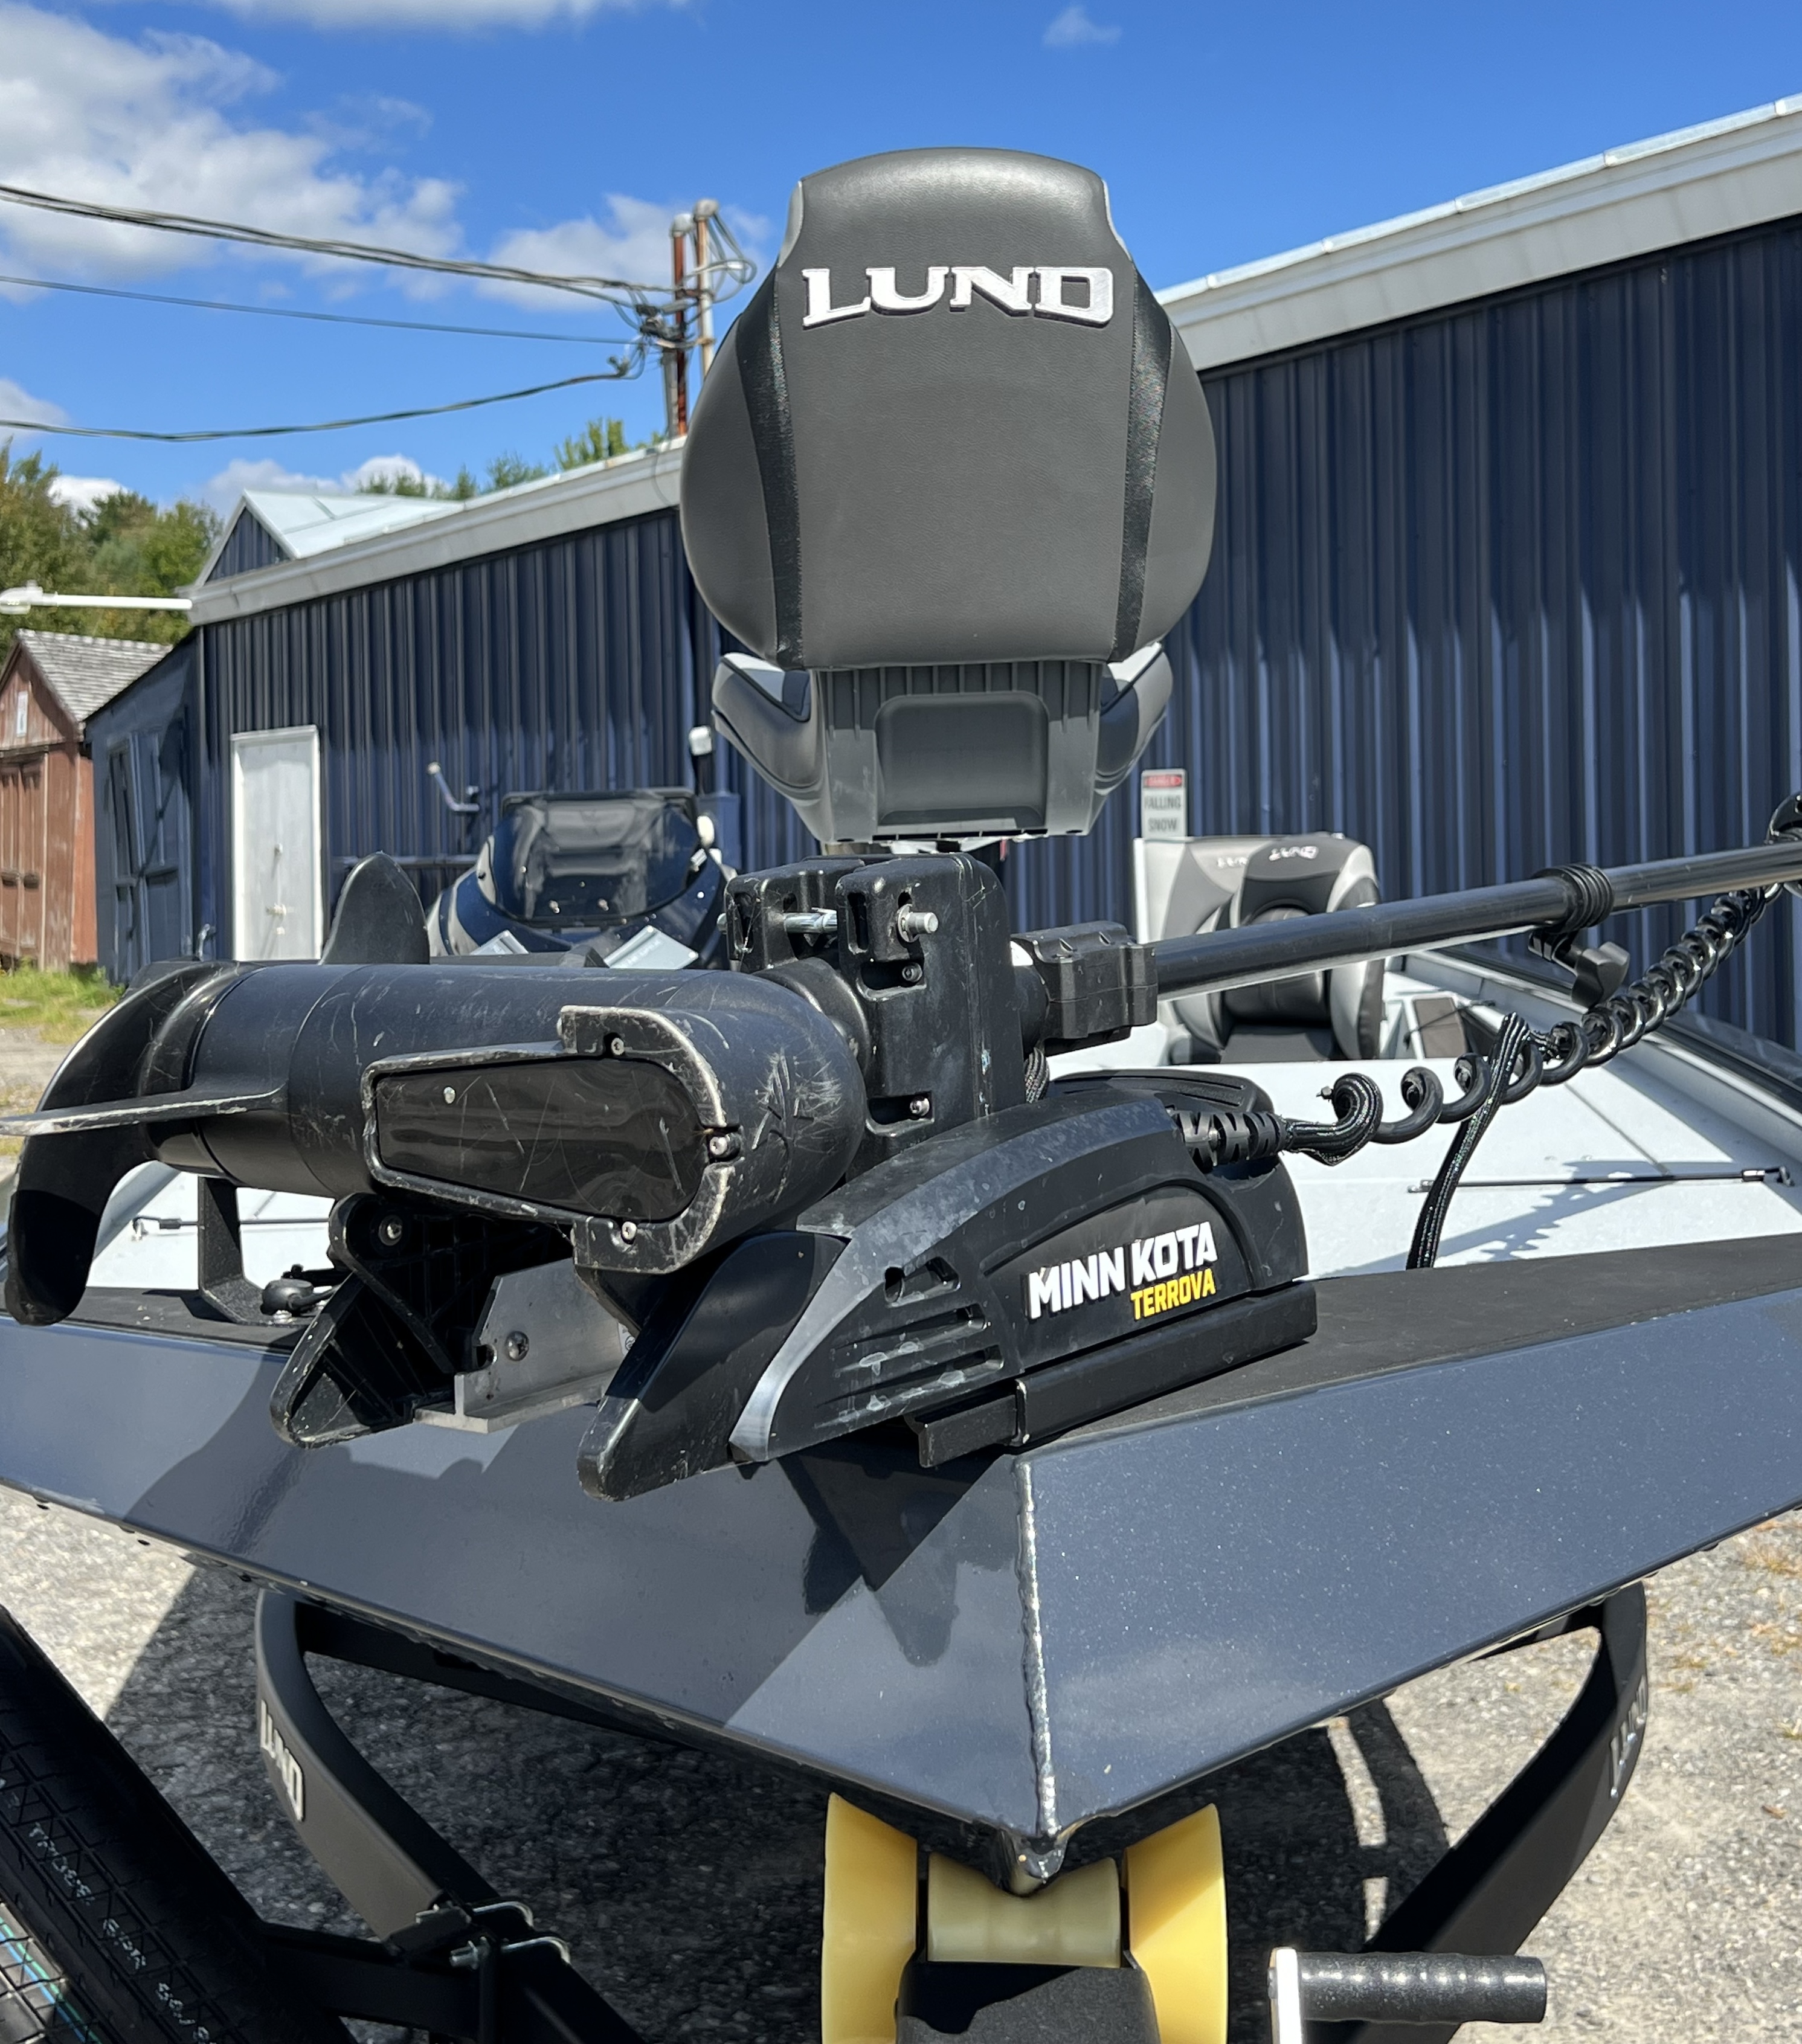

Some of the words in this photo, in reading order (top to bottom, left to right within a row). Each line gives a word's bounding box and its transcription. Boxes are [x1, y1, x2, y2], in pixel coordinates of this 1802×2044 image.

[802, 266, 1114, 330] LUND
[1144, 795, 1181, 811] FALLING
[1148, 817, 1177, 832] SNOW
[1028, 1247, 1125, 1320] MINN
[1131, 1221, 1218, 1286] KOTA
[1130, 1268, 1216, 1320] TERROVA
[260, 1699, 304, 1822] LUND
